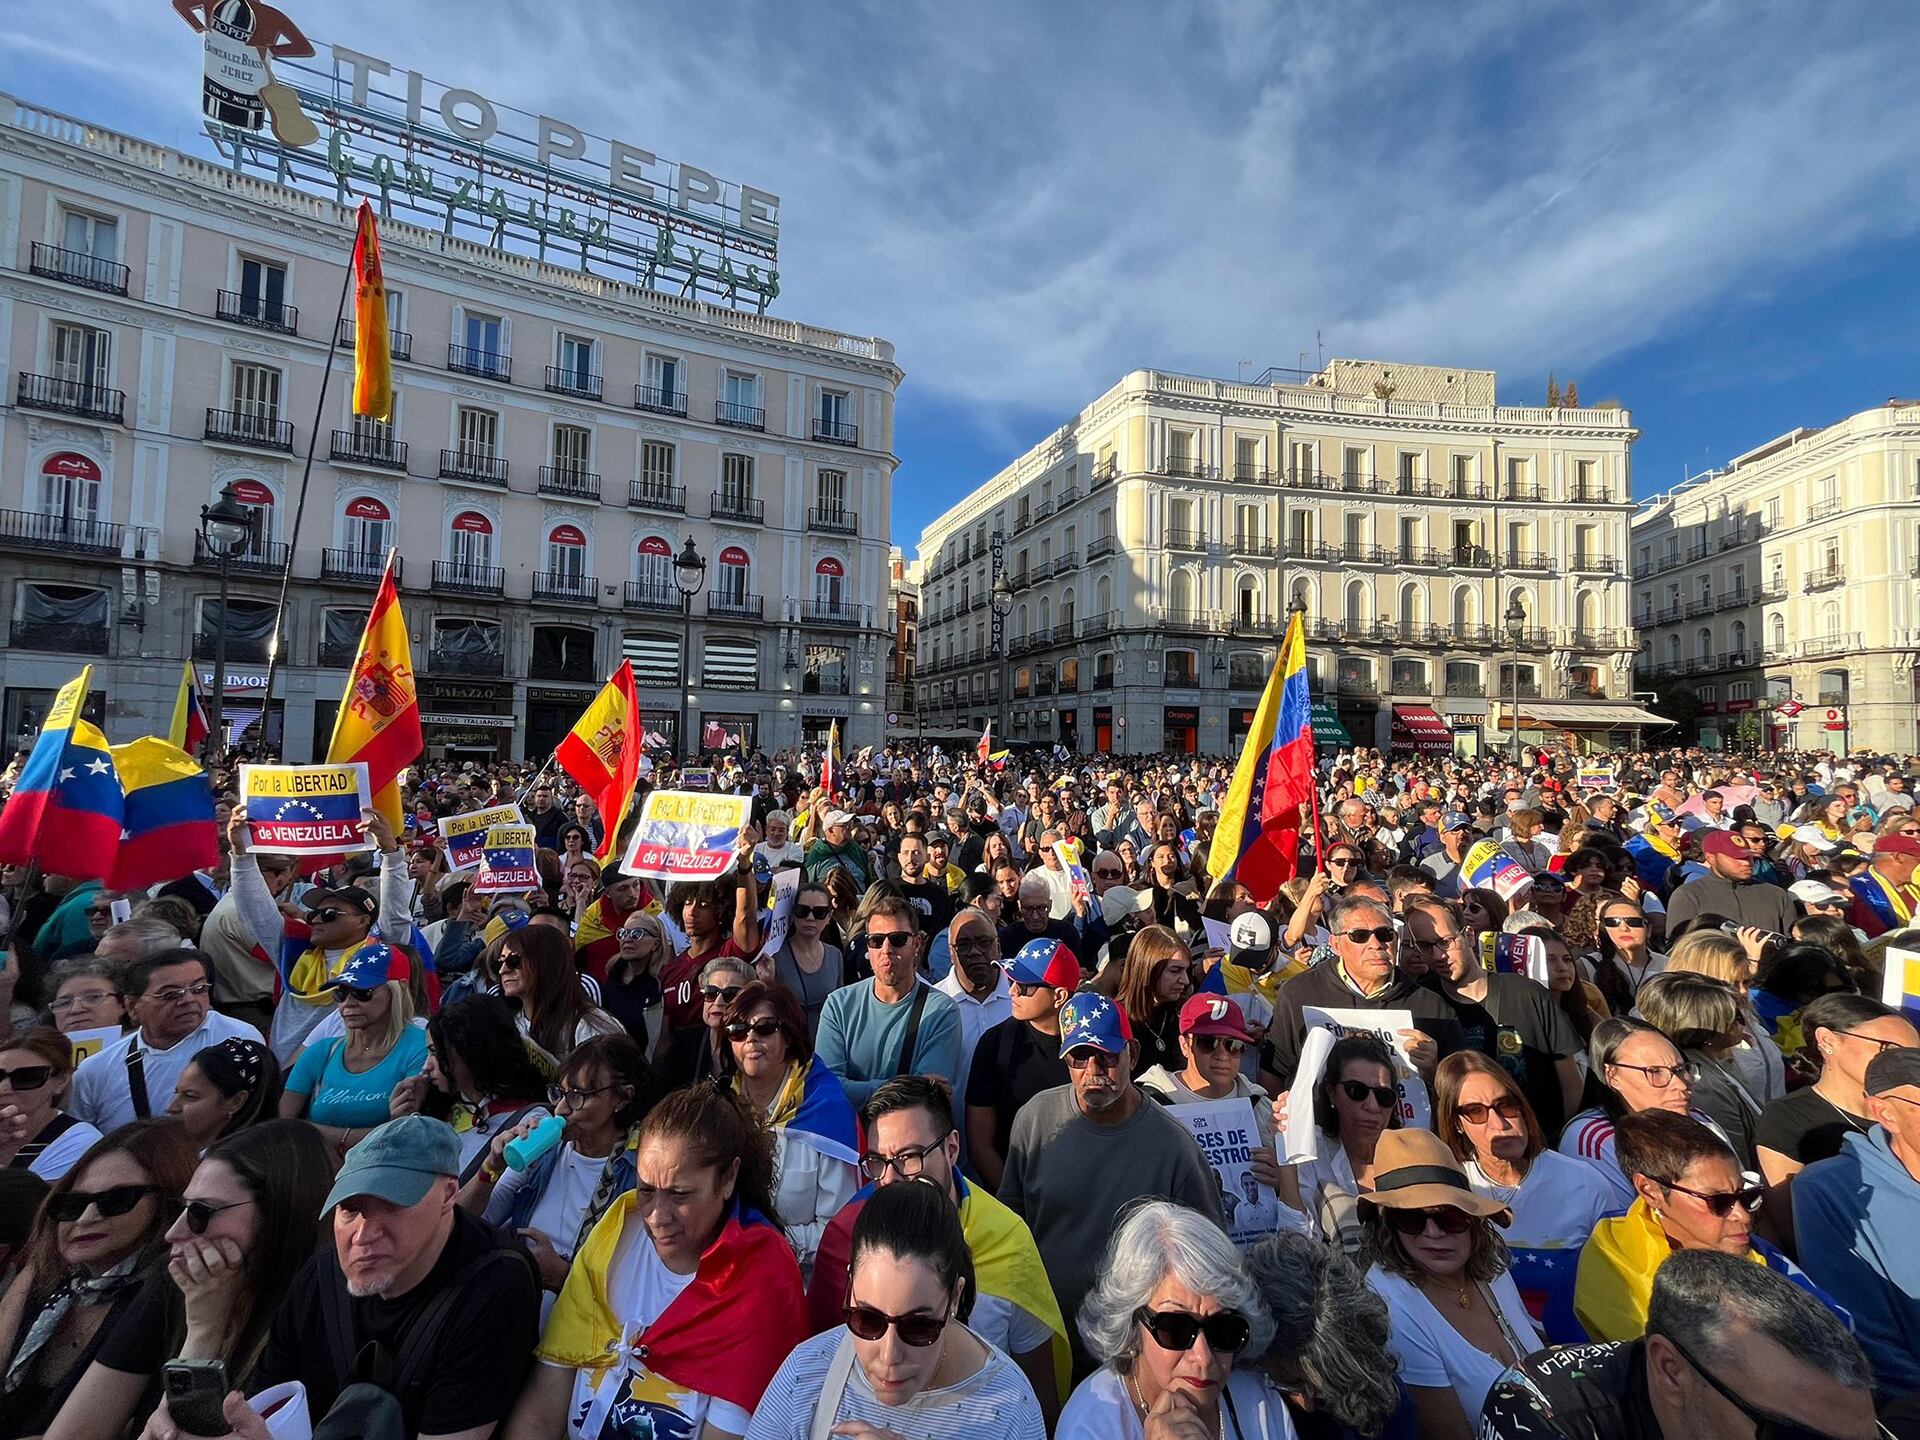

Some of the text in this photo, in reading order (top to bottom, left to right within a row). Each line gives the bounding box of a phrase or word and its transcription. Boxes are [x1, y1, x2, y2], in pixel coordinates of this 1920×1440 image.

[220, 64, 254, 82] JEREZ
[208, 84, 229, 98] FINO
[332, 43, 780, 240] TIO PEPE
[328, 128, 781, 300] GONZALEZ BYASS
[435, 687, 494, 699] PALAZZO
[804, 707, 849, 716] SEPHORA
[1167, 711, 1195, 720] Orange
[420, 716, 504, 726] HELADOS ITALIANOS
[253, 773, 348, 792] Por la LIBERTAD
[451, 810, 514, 833] Por la LIBERTAD
[258, 825, 352, 841] de VENEZUELA
[458, 852, 468, 861] de
[642, 850, 723, 868] de VENEZUELA
[1466, 860, 1476, 874] Por
[1472, 853, 1483, 862] la
[480, 871, 534, 883] VENEZUELA
[1484, 944, 1494, 953] la
[677, 980, 690, 1005] 10
[1227, 1129, 1249, 1146] DE
